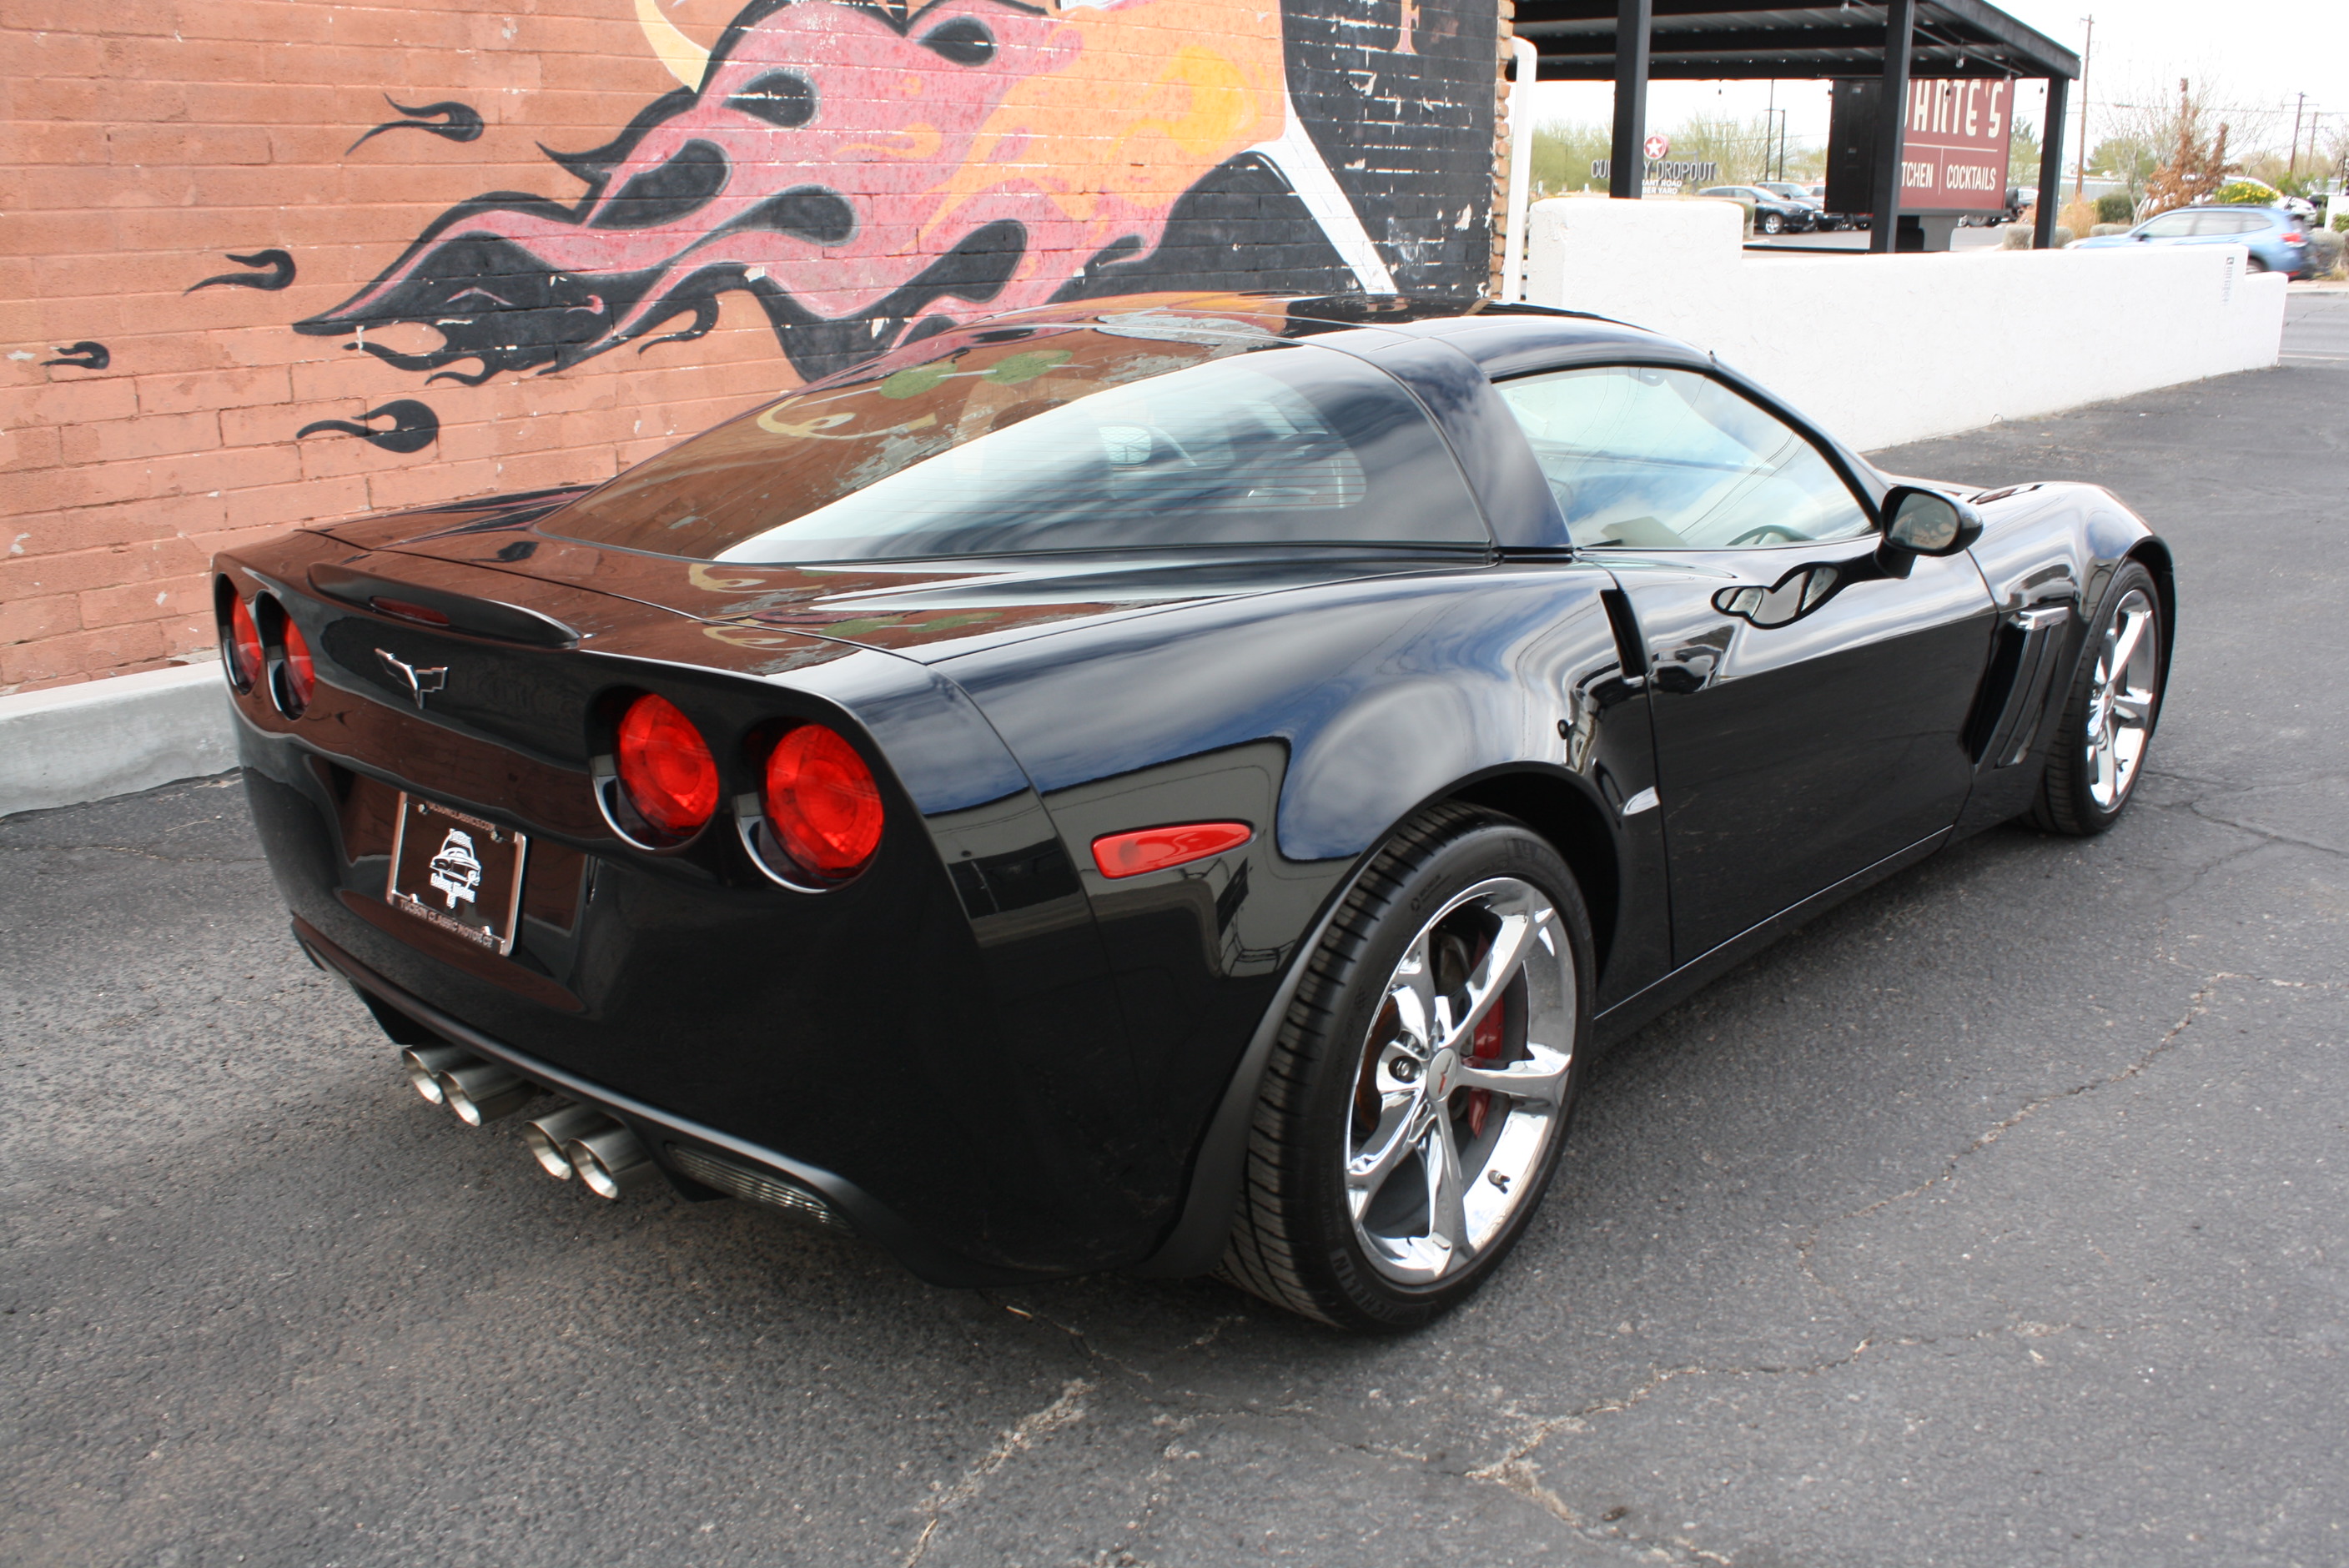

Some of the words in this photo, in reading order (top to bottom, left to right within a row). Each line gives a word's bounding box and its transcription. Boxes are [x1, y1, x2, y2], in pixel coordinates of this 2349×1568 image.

[1656, 161, 1717, 182] DROPOUT
[1901, 161, 1934, 188] TCHEN
[1946, 164, 1996, 191] COCKTAILS
[1642, 186, 1657, 194] BER
